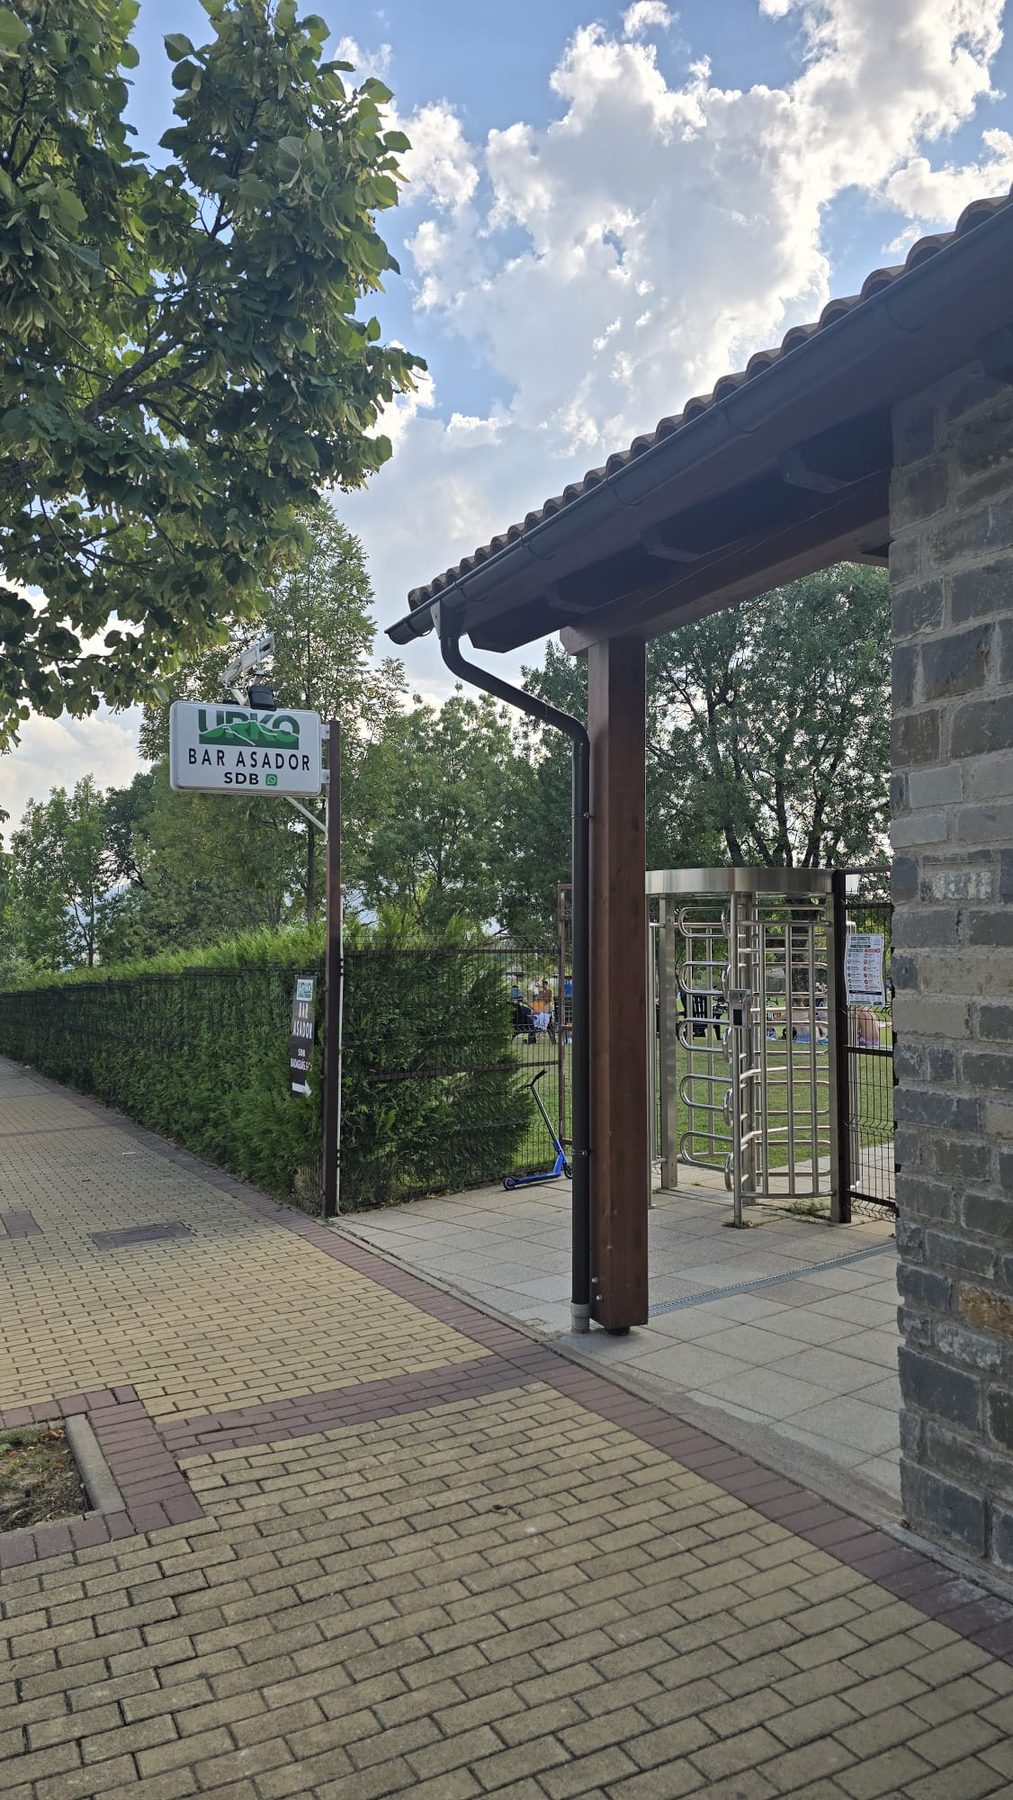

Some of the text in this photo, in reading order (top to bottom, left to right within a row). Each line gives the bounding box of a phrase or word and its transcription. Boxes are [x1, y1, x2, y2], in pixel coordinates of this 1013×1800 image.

[188, 748, 310, 771] BAR ASADOR
[224, 771, 259, 785] SDB
